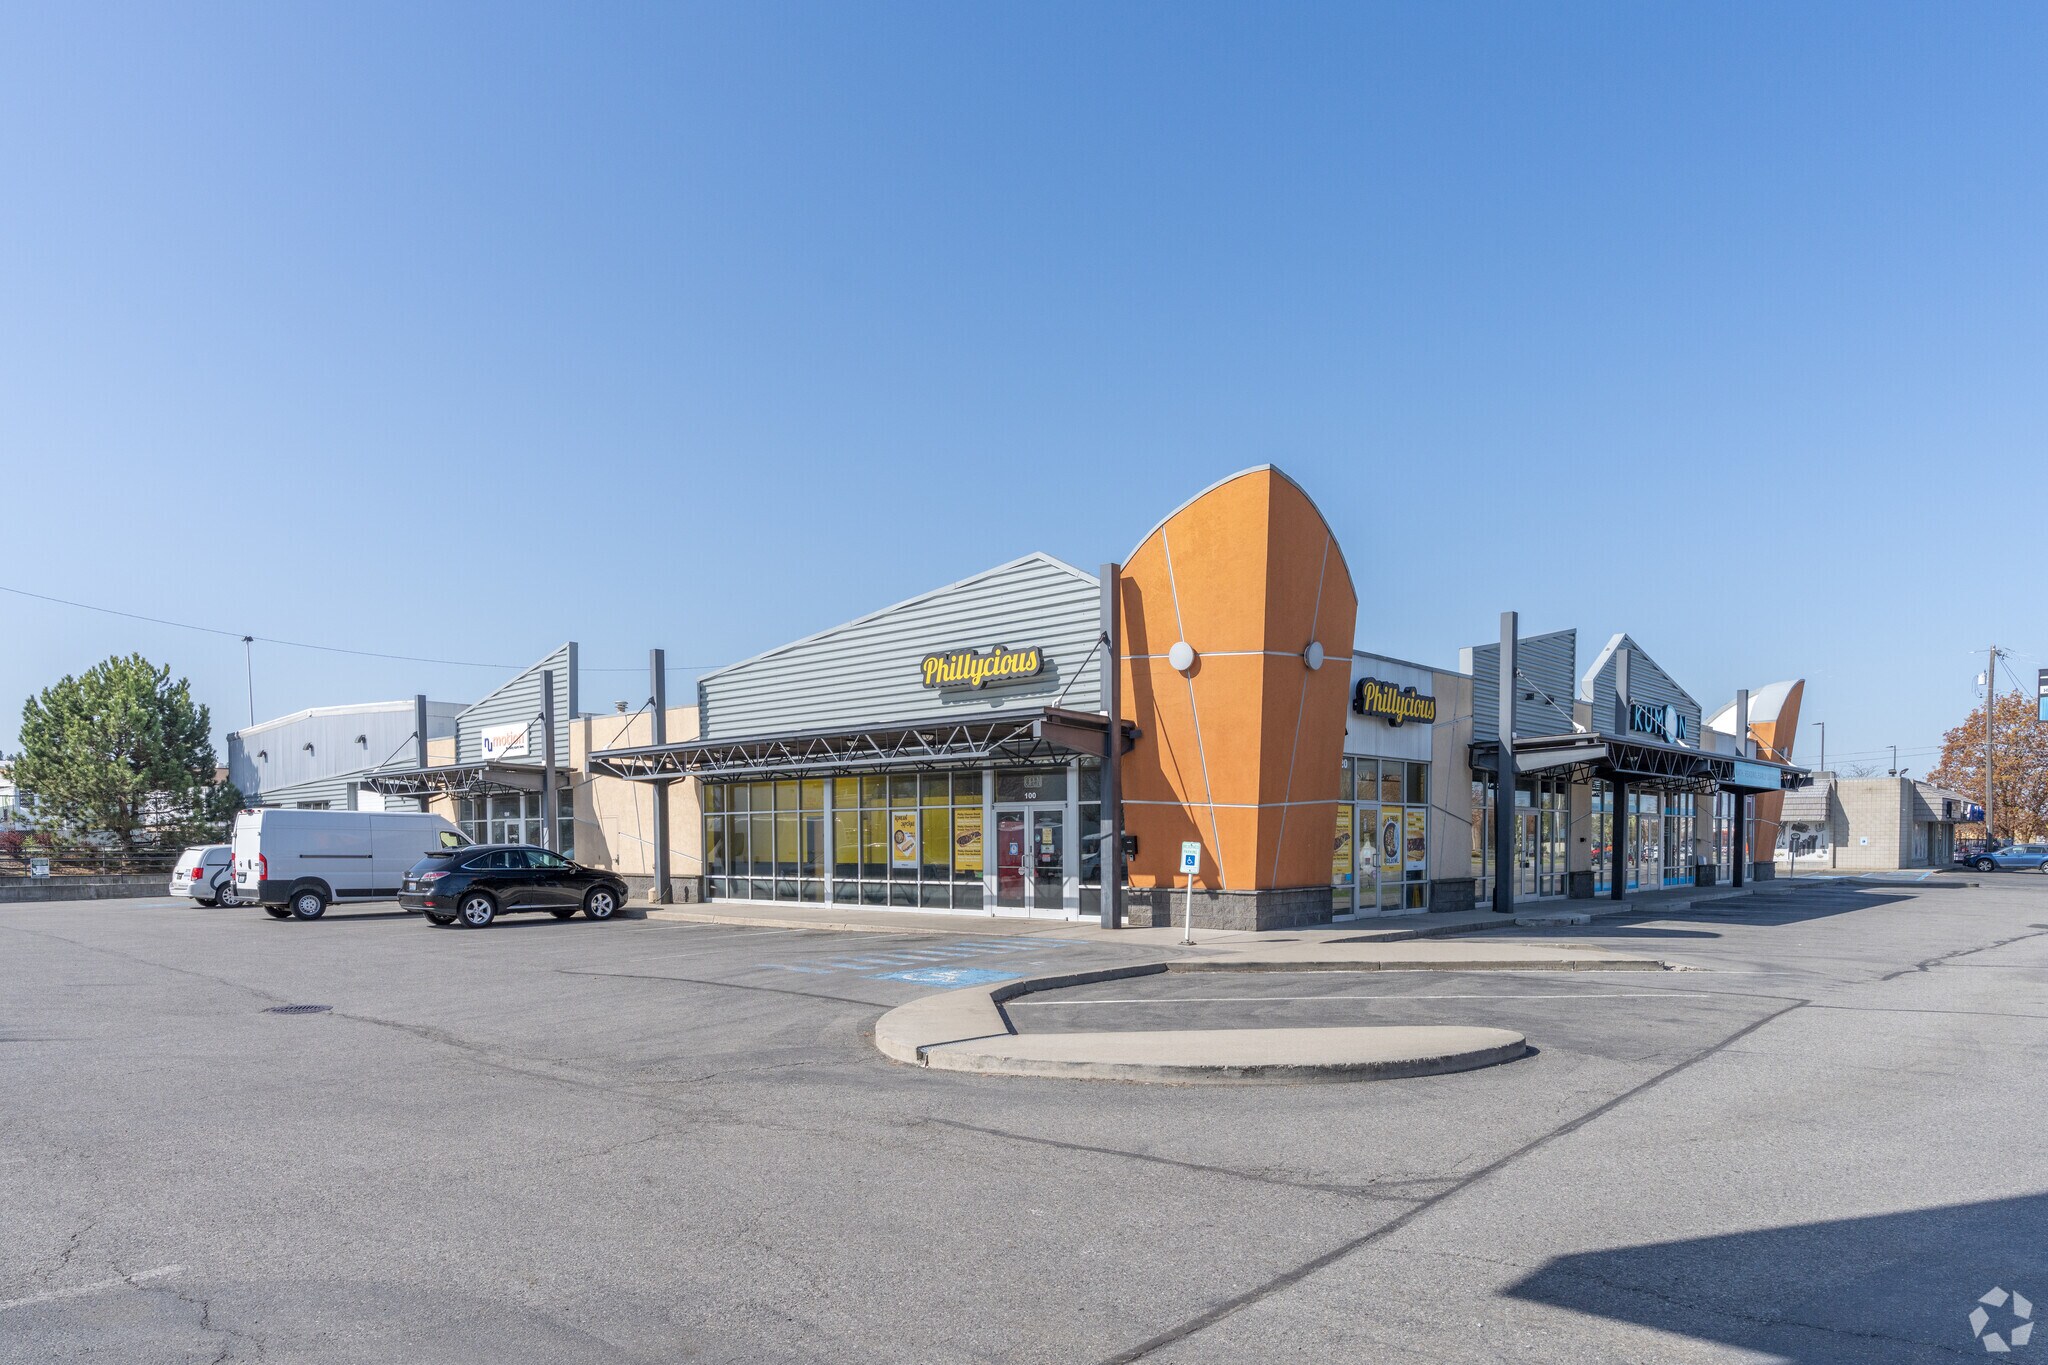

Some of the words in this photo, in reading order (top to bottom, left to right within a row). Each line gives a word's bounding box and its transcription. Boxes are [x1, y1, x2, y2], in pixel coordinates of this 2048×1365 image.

[923, 649, 1037, 685] Phillycious
[1364, 682, 1435, 723] Phillycious
[1634, 704, 1687, 744] KUMON
